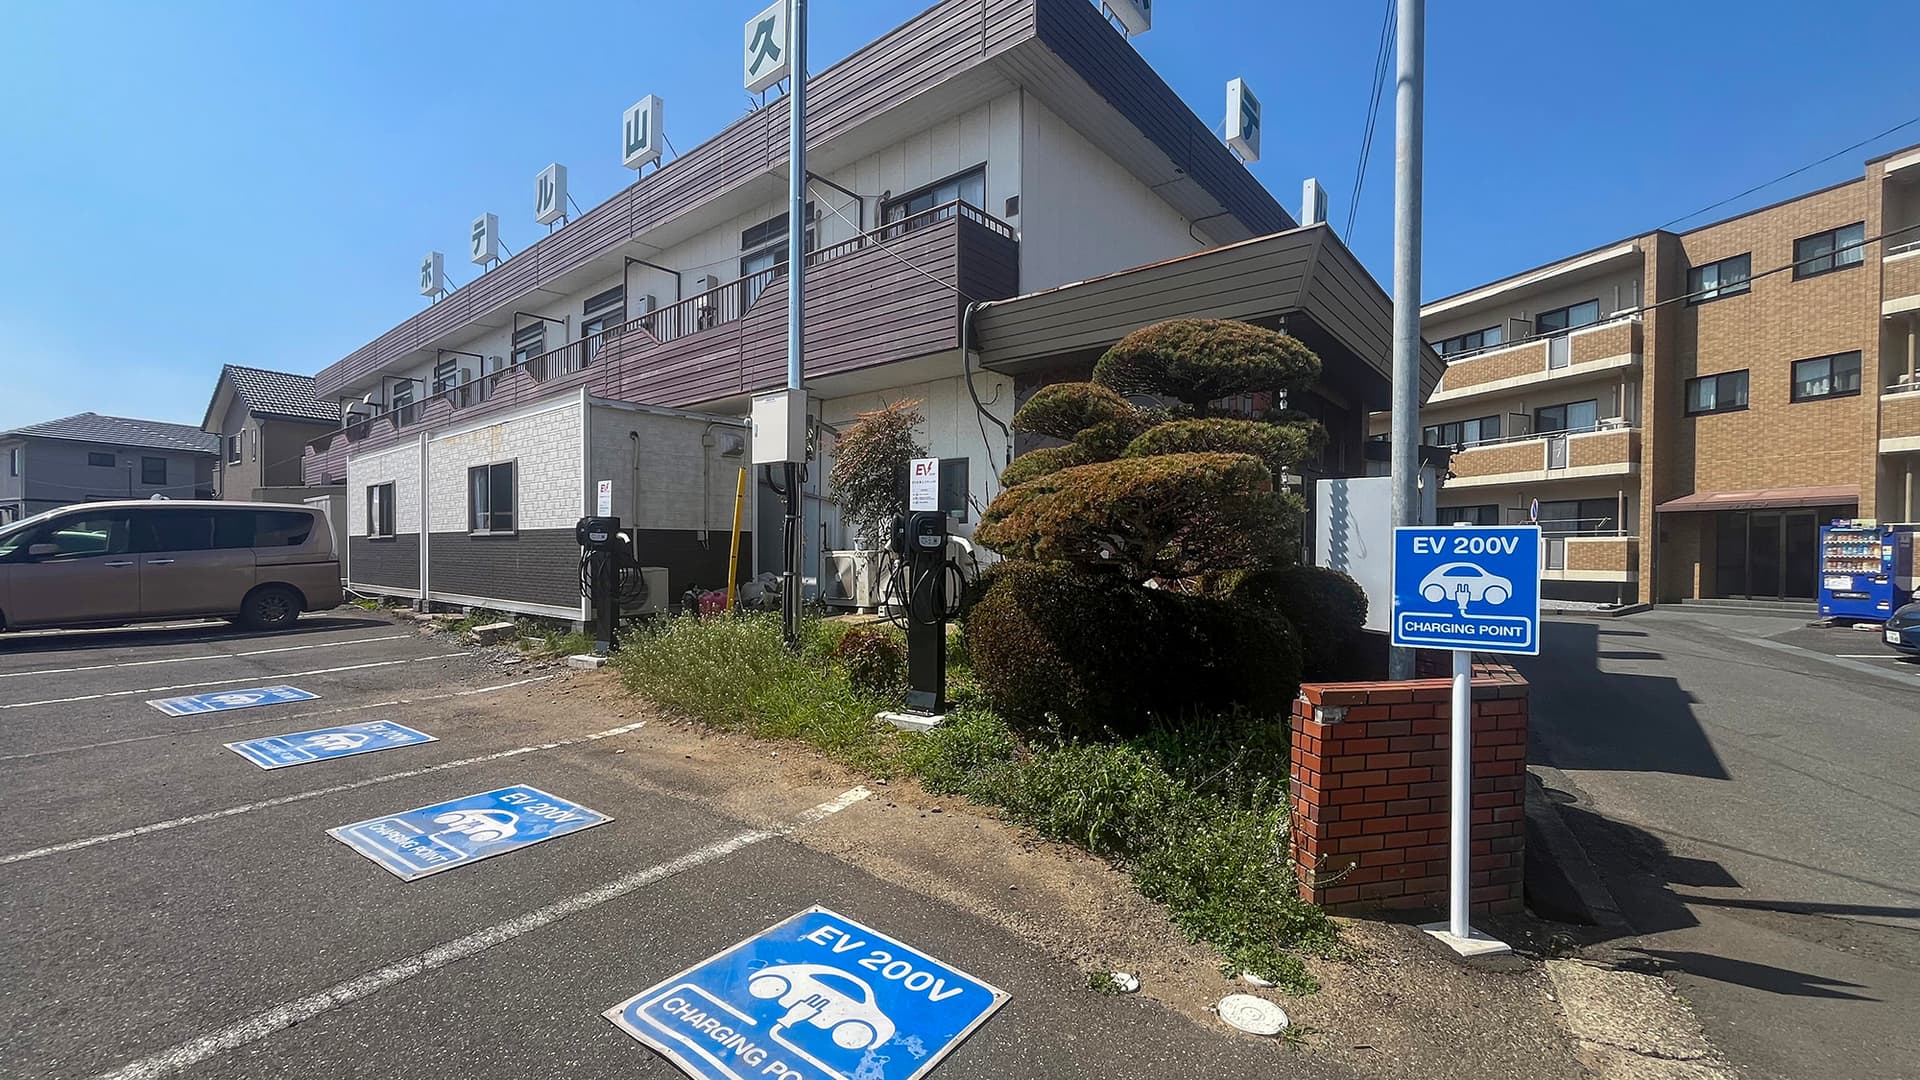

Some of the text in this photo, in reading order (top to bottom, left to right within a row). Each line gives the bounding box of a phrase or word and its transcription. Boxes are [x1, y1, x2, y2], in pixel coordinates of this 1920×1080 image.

[421, 14, 781, 288] ホ テ ル 山 久
[1413, 536, 1519, 555] EV 200V
[1405, 621, 1523, 637] CHARGING POINT
[499, 792, 586, 824] EV 200V
[368, 823, 448, 864] CHARGING POINT
[807, 925, 963, 1002] EV 200V
[662, 997, 768, 1067] CHARGING
